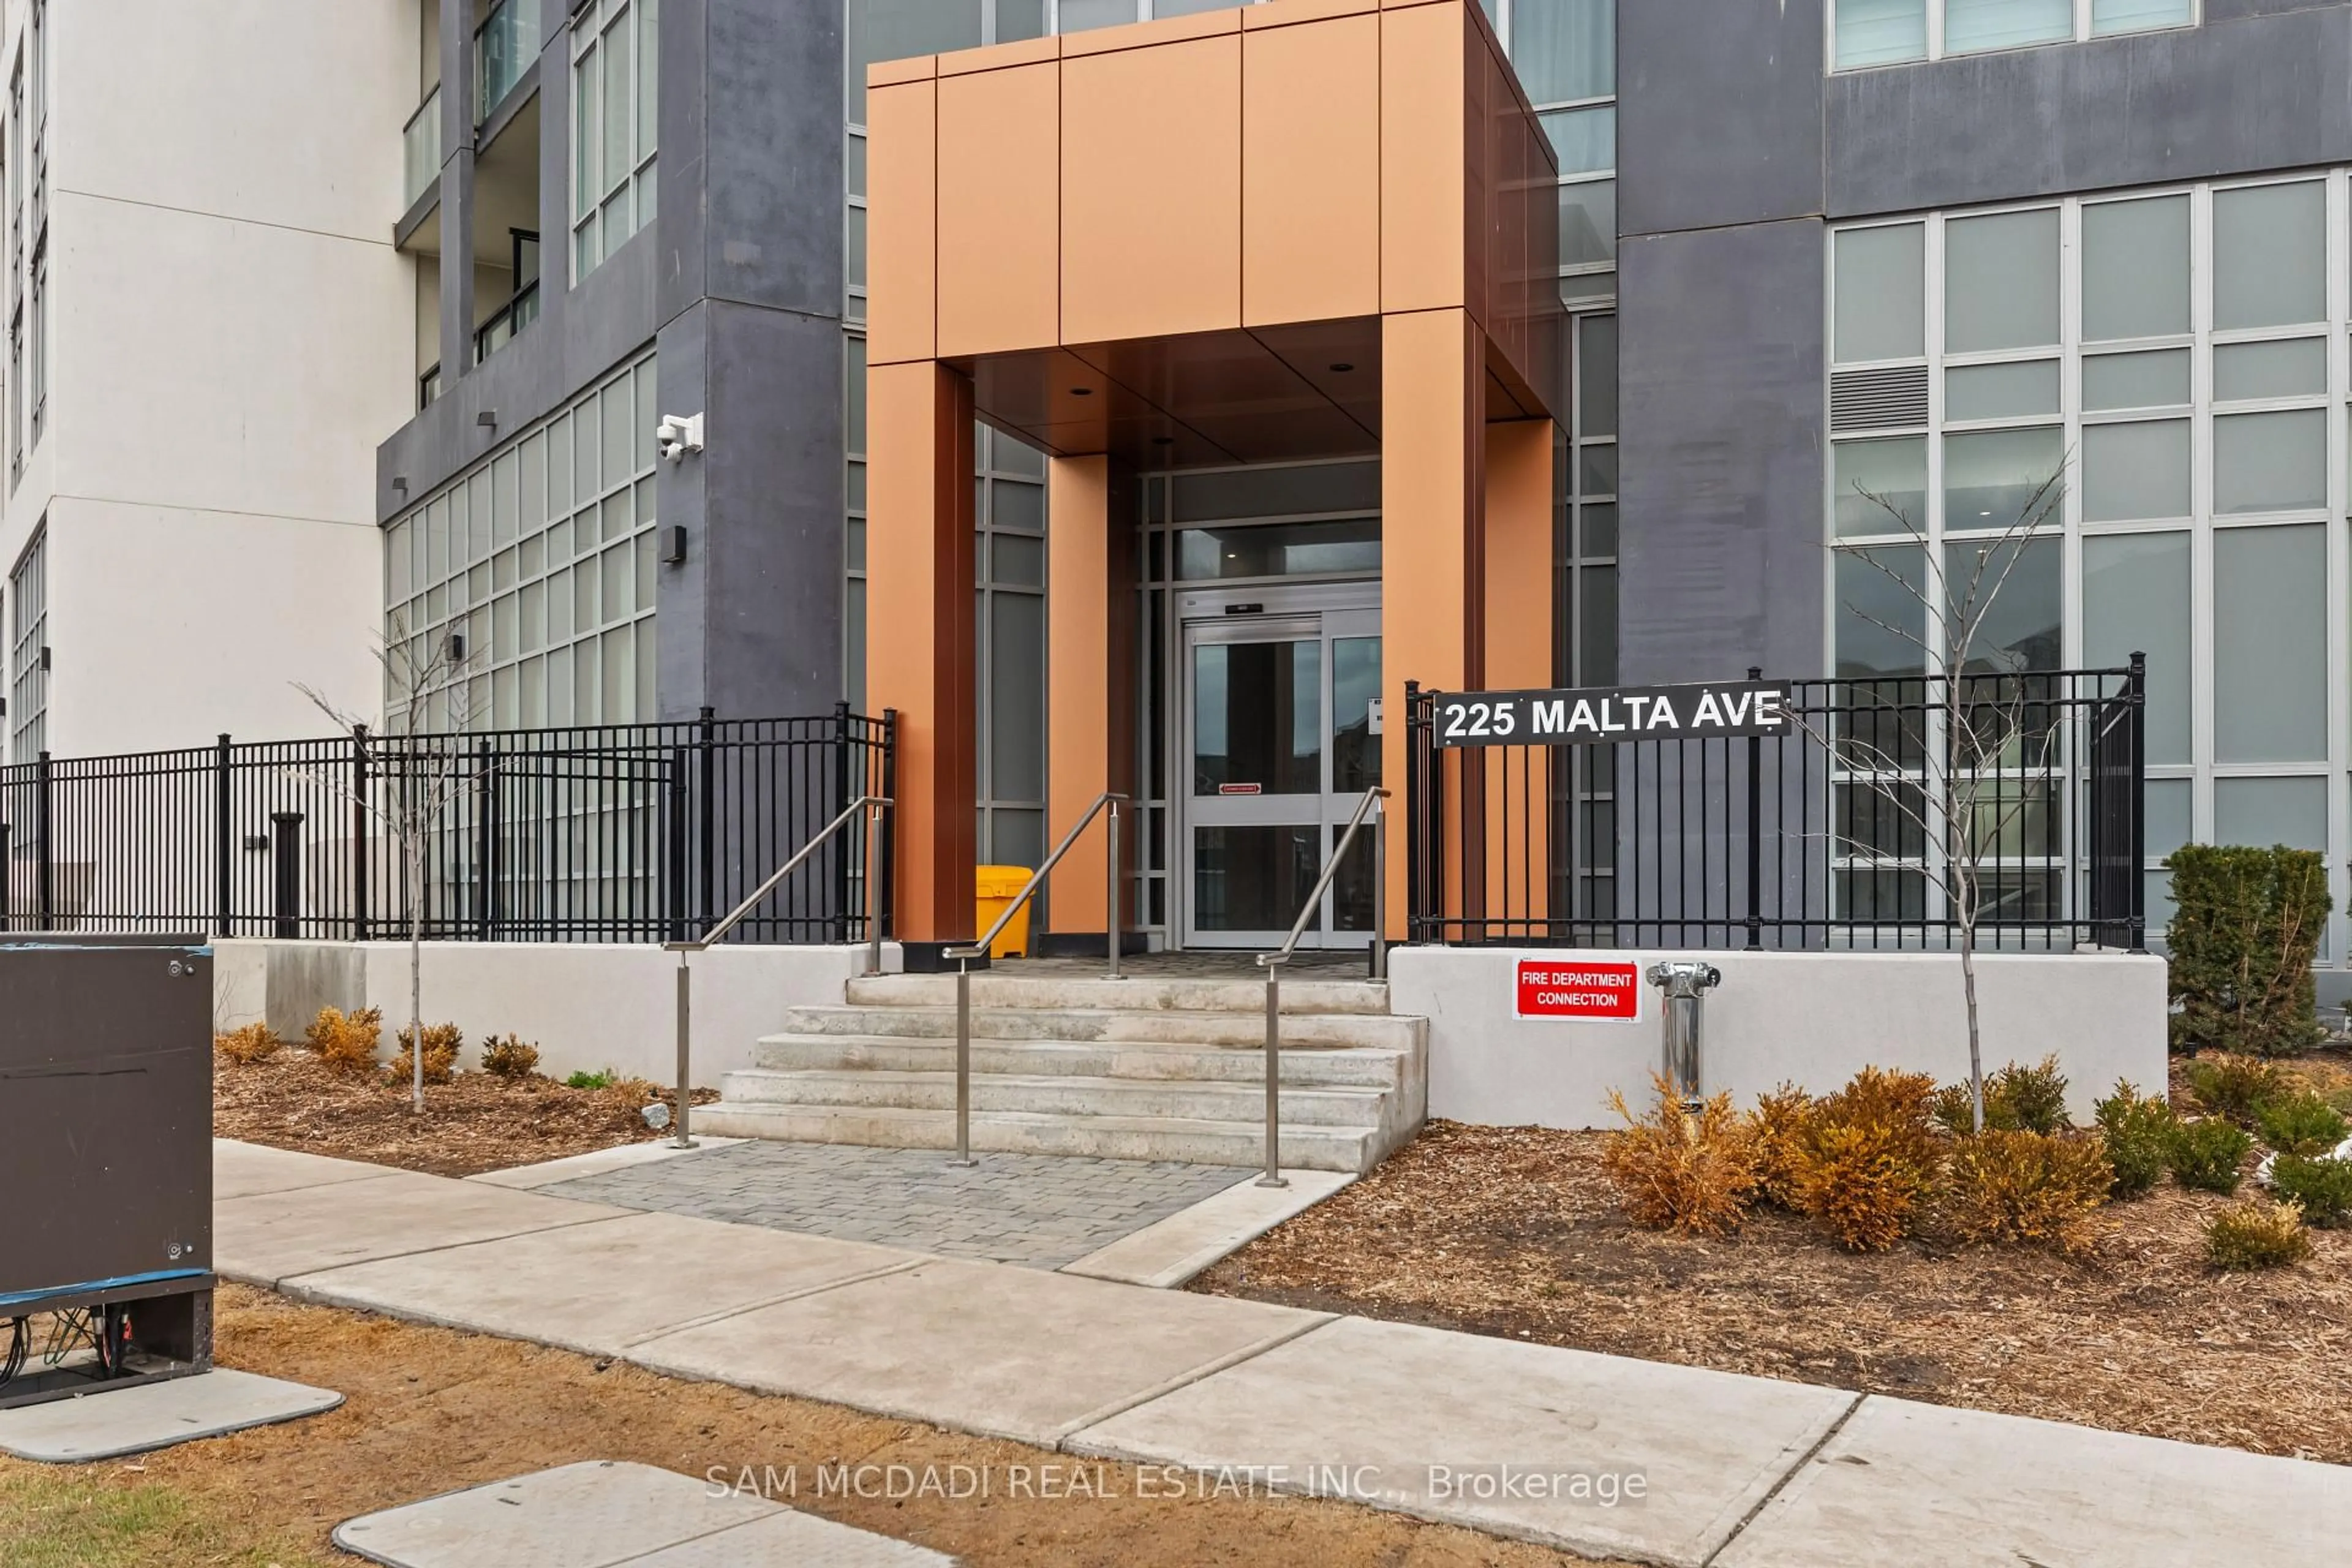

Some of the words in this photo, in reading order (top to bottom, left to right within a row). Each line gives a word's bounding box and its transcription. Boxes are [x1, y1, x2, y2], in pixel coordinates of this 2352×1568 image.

[1444, 703, 1515, 737] 225
[1532, 696, 1680, 734] MALTA
[1691, 690, 1782, 728] AVE
[1522, 971, 1548, 986] FIRE
[1551, 973, 1633, 987] DEPARTMENT
[1537, 992, 1618, 1007] CONNECTION
